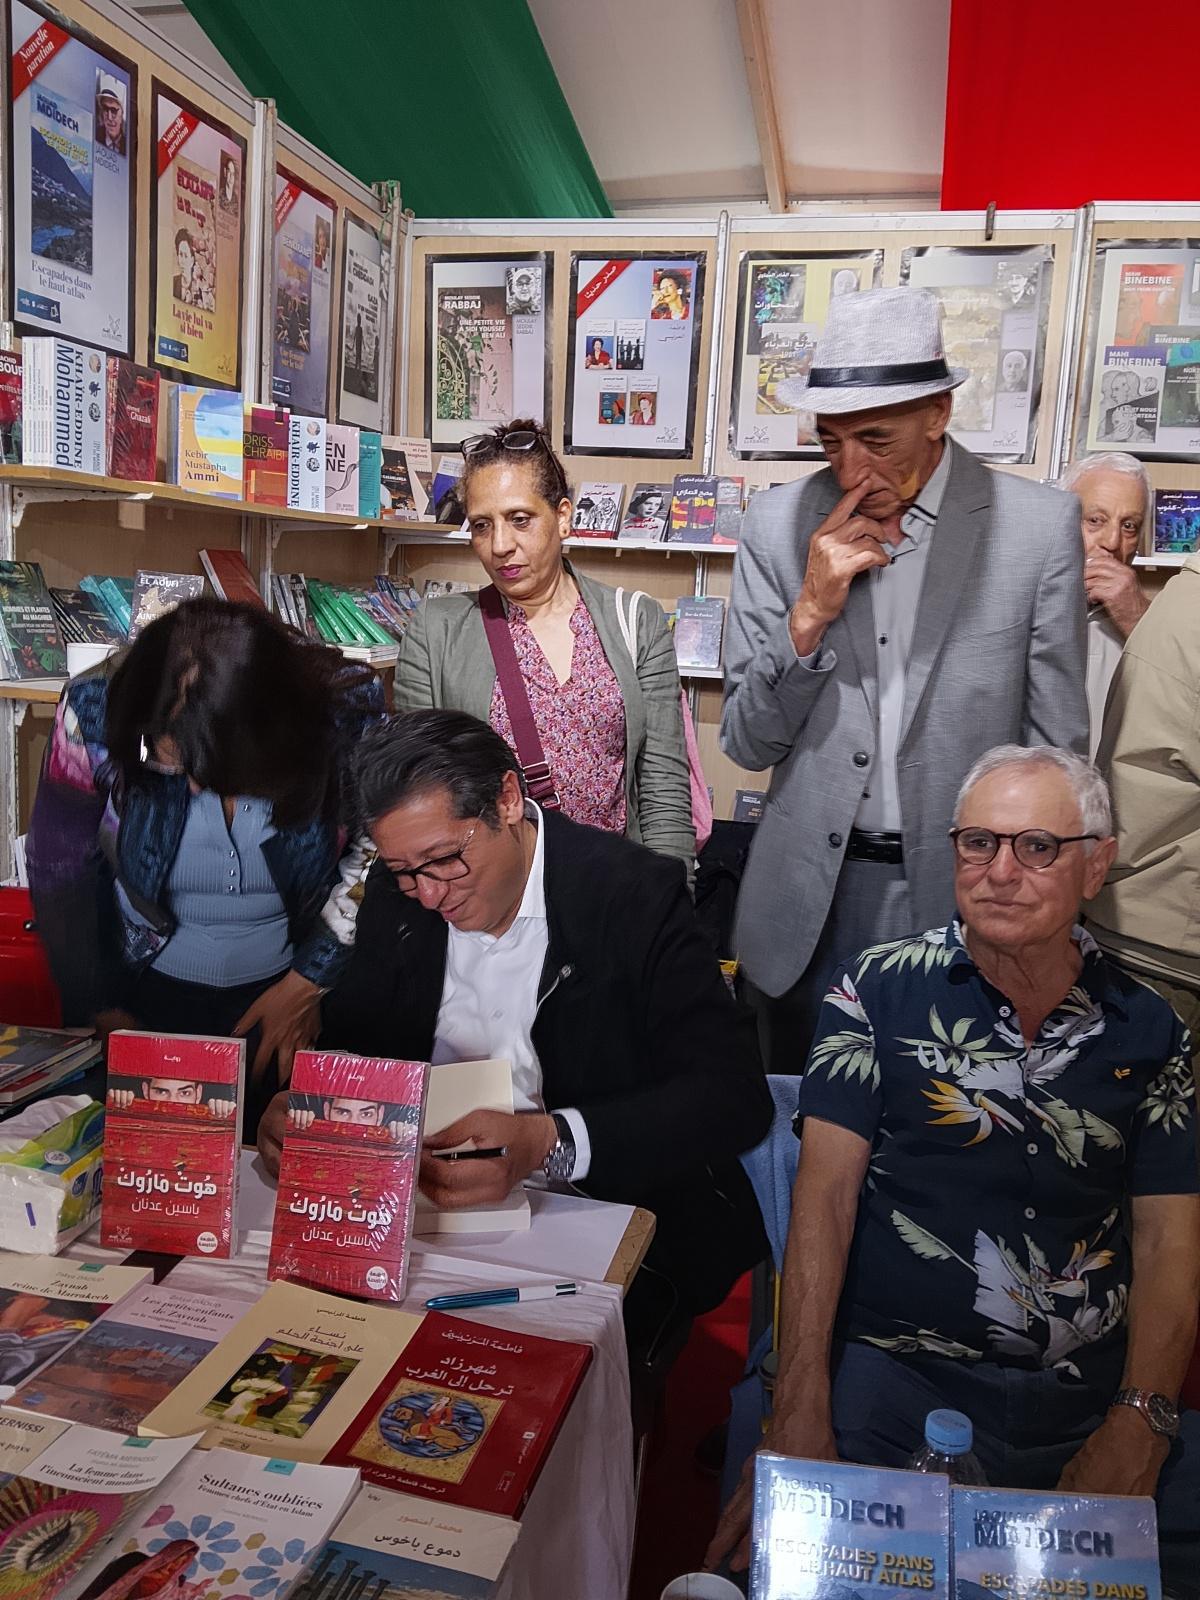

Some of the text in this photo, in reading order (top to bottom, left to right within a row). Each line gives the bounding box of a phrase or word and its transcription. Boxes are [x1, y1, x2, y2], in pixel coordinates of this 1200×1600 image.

[19, 28, 49, 63] Nouvelle
[26, 40, 55, 77] parution
[73, 274, 92, 291] dans
[1124, 276, 1173, 285] BINEBINE
[66, 283, 86, 301] atlas
[444, 300, 481, 309] RABBAJ
[193, 311, 204, 327] lui
[205, 319, 213, 330] va
[187, 324, 204, 340] bien
[1108, 358, 1162, 367] BINEBINE
[56, 342, 76, 468] Mohammed
[73, 350, 84, 470] KHAÏR-EDDINE
[243, 433, 274, 448] DRISS
[184, 448, 208, 459] Kebir
[184, 460, 227, 473] Mustapha
[184, 470, 220, 483] Ammi
[131, 1196, 163, 1213] عدنان
[302, 1225, 333, 1242] عدنان
[39, 1285, 52, 1295] de
[53, 1288, 110, 1301] Marrakech
[141, 1296, 235, 1320] Les petits-enfants
[152, 1307, 167, 1315] de
[275, 1328, 309, 1341] الحلم
[309, 1325, 346, 1339] نساء
[405, 1367, 448, 1381] الغرب
[440, 1356, 497, 1376] شهرزاد
[468, 1381, 514, 1396] ترحل
[39, 1463, 105, 1485] l'inconscient
[68, 1463, 84, 1472] La
[85, 1465, 119, 1478] femme
[120, 1469, 144, 1479] dans
[199, 1472, 324, 1510] Sultanes oubliées
[198, 1484, 231, 1500] Femmes
[231, 1491, 252, 1504] chefs
[278, 1504, 290, 1512] en
[290, 1505, 313, 1518] Islam
[435, 1521, 464, 1533] محمد
[375, 1532, 461, 1558] دموع باخوس
[775, 1538, 878, 1565] ESCAPADES
[882, 1552, 935, 1571] DANS
[823, 1561, 873, 1581] HAUT
[878, 1569, 934, 1588] ATLAS
[980, 1572, 1148, 1600] ESCAPADES DANS
